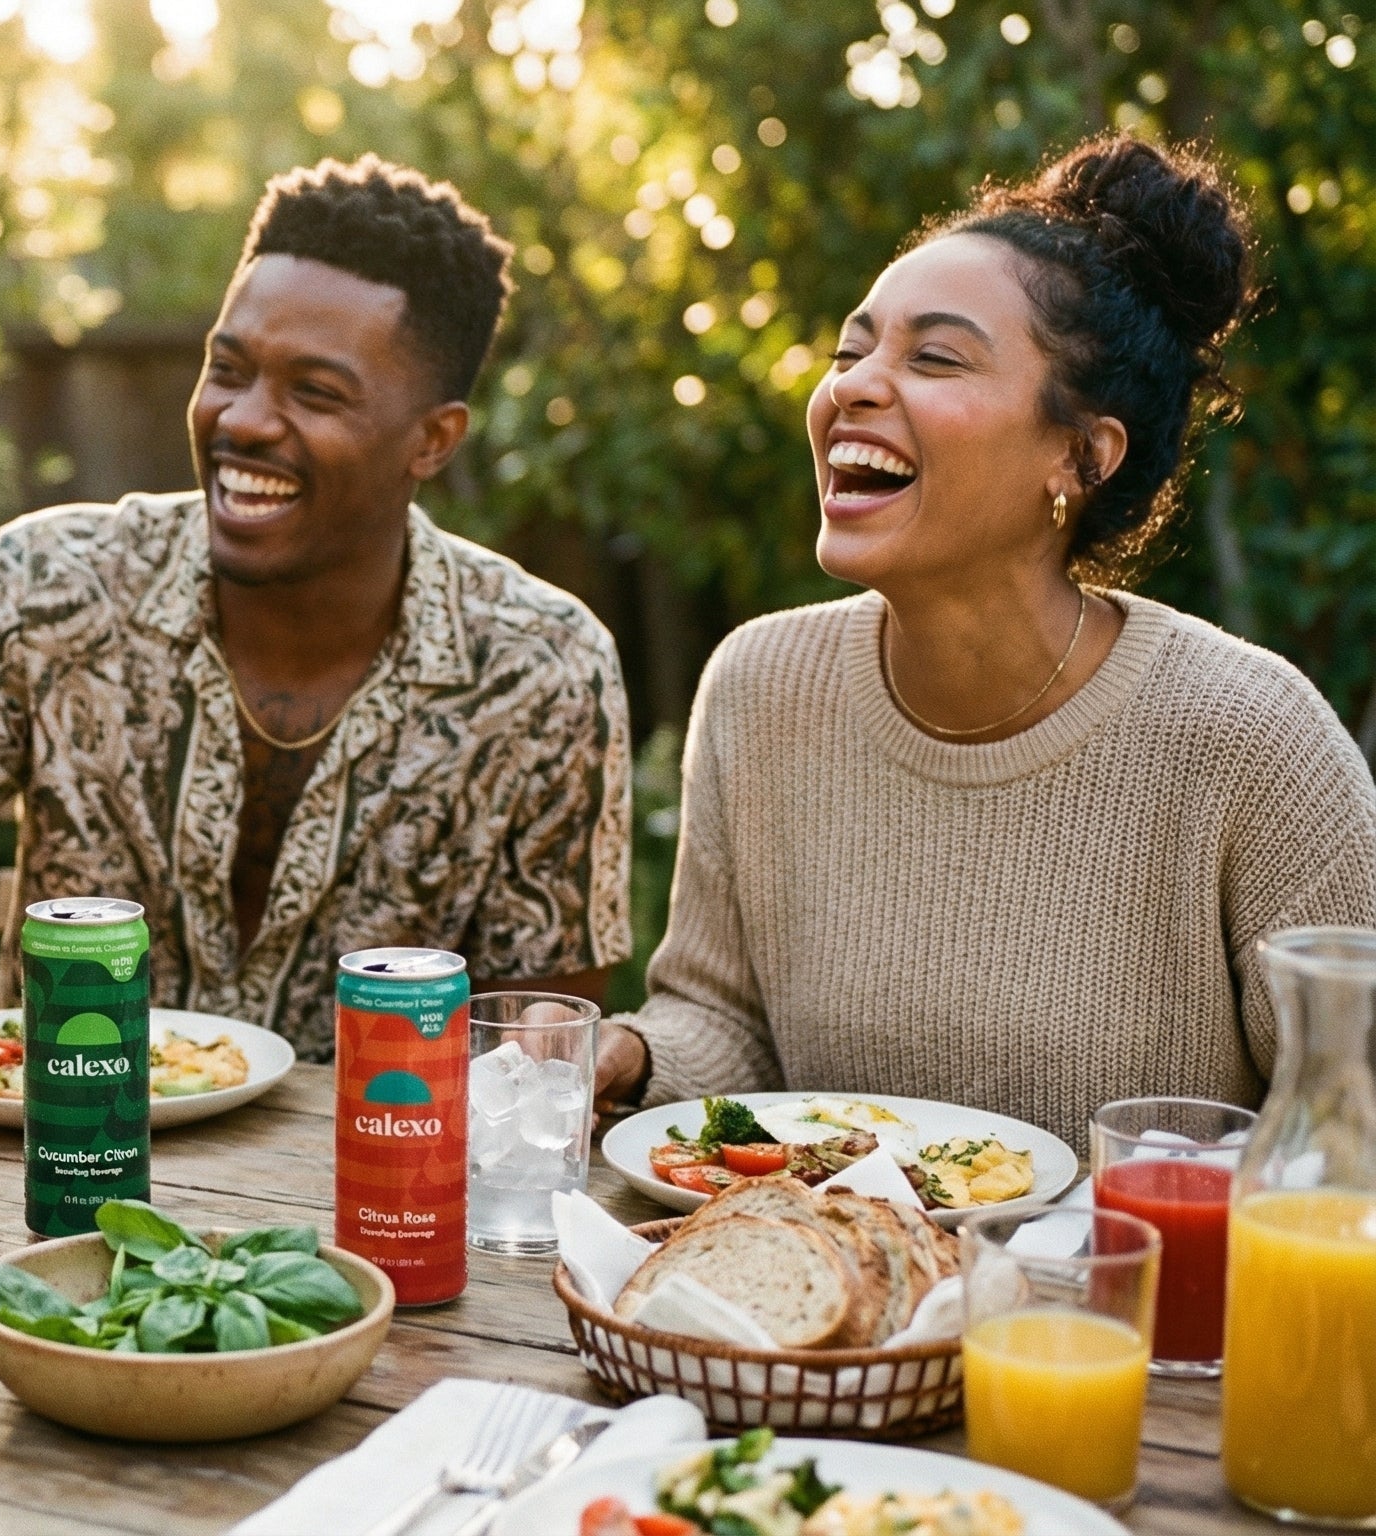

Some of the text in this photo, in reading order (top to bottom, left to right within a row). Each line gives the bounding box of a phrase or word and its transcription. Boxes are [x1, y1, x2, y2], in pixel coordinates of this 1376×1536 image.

[47, 1053, 130, 1077] calexo
[355, 1112, 442, 1137] calexo
[38, 1146, 102, 1164] Cucumber
[358, 1207, 436, 1225] Citrus Rose
